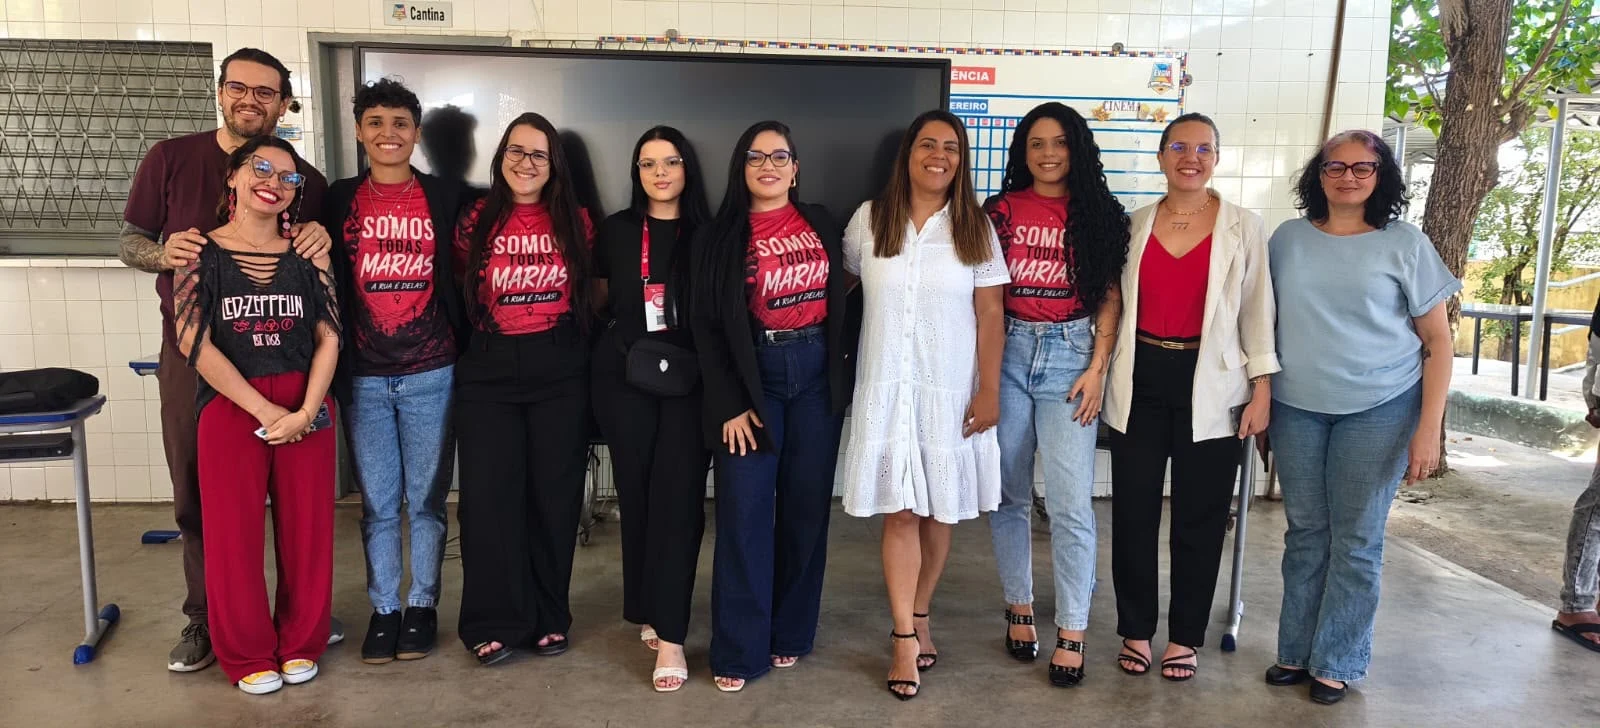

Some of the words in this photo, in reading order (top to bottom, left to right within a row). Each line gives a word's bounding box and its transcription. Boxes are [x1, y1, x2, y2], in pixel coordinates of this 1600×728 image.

[410, 6, 445, 21] Cantina
[362, 216, 434, 240] SOMOS
[377, 239, 423, 253] TODAS
[756, 231, 823, 257] SOMOS
[360, 253, 434, 279] MARIAS
[509, 253, 554, 266] TODAS
[777, 249, 822, 267] TODAS
[492, 265, 567, 293] MARIAS
[1015, 287, 1021, 295] A
[774, 299, 780, 307] A
